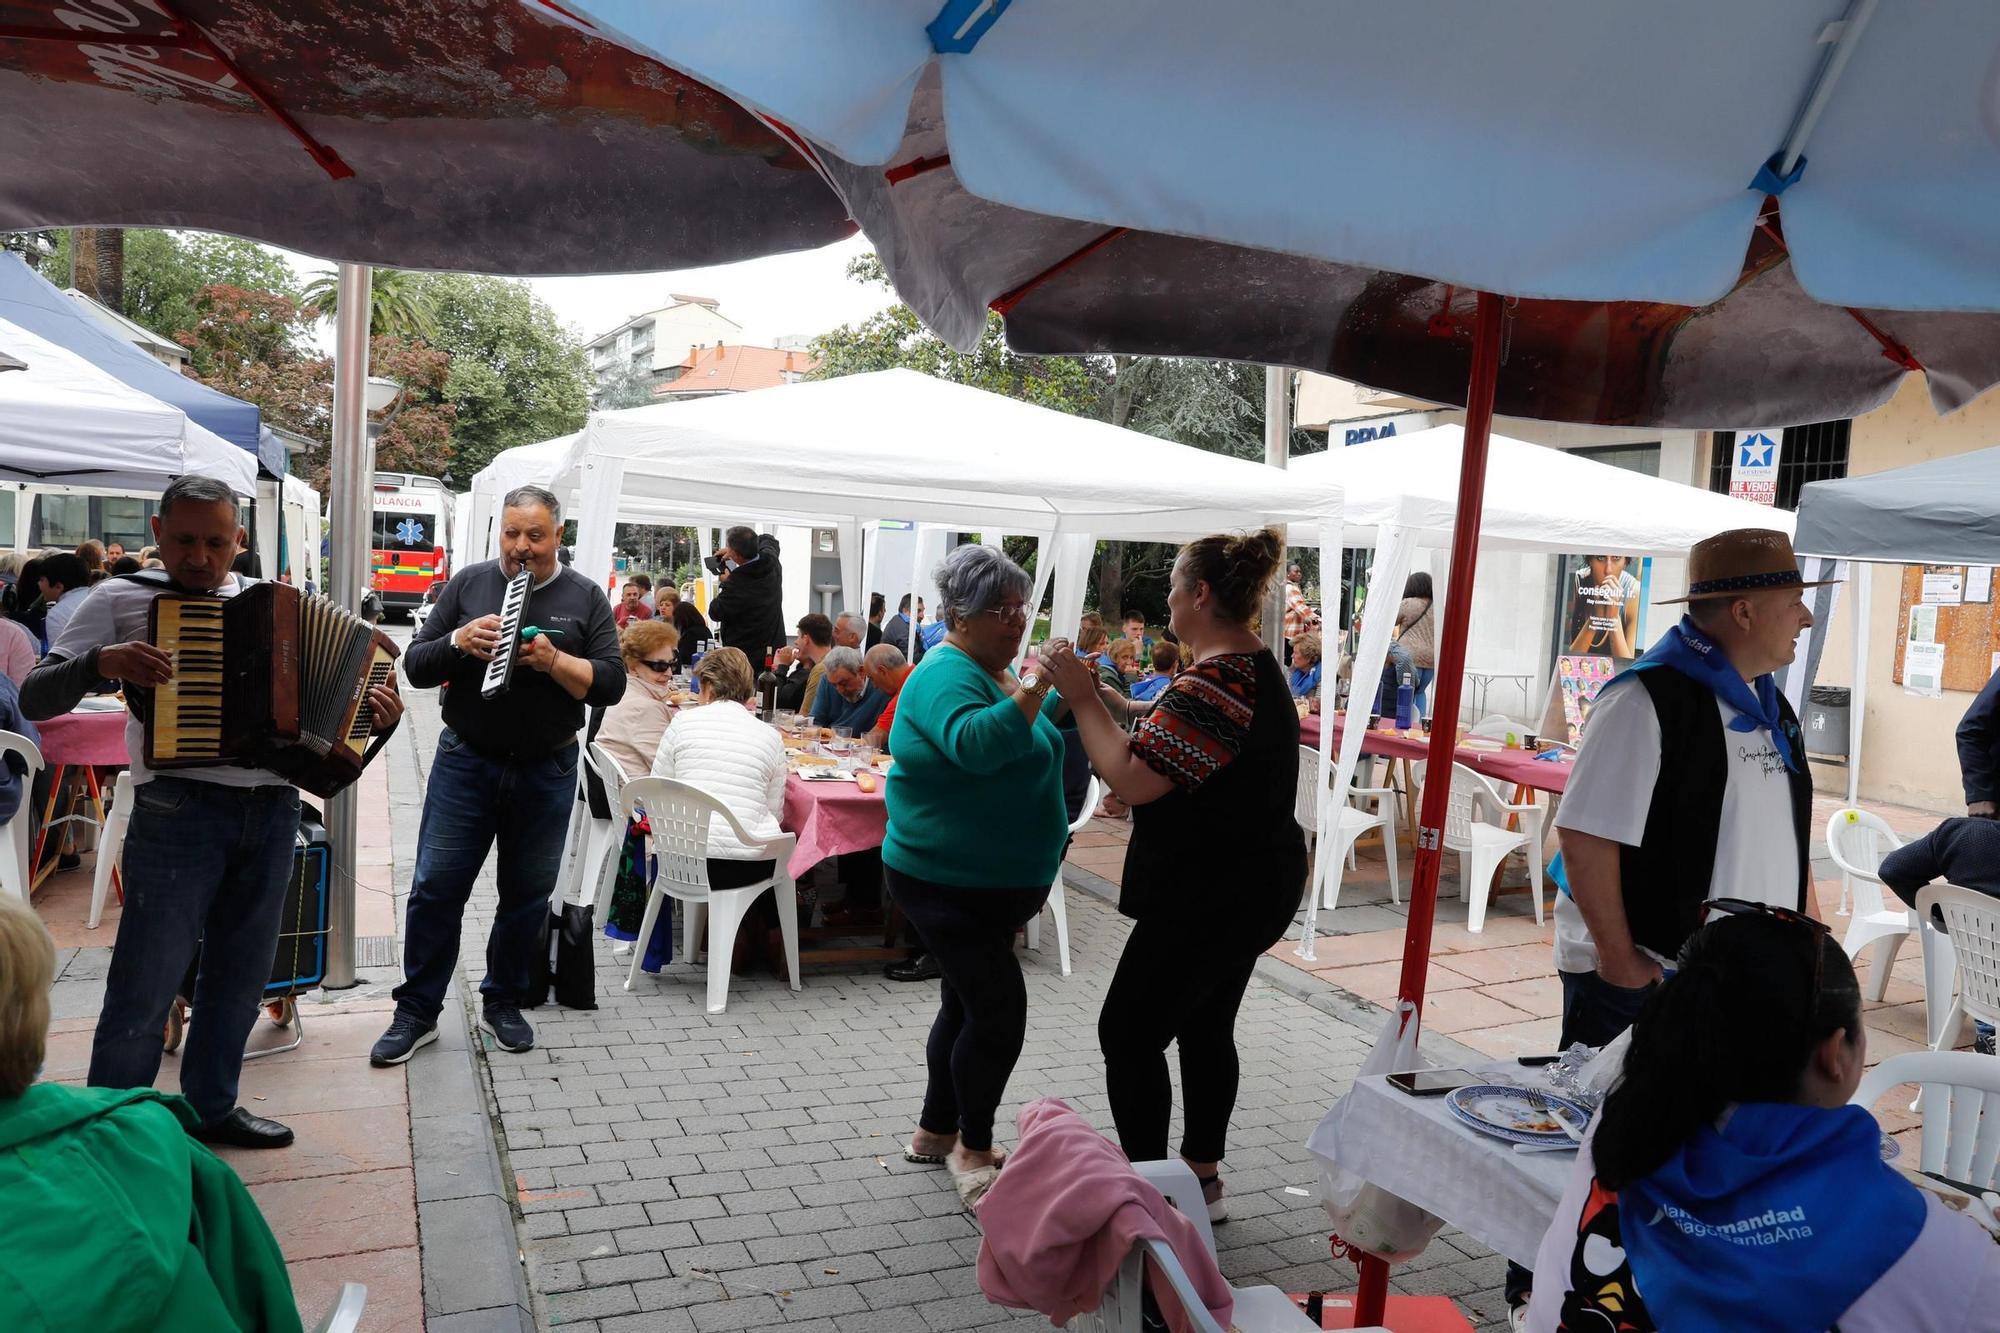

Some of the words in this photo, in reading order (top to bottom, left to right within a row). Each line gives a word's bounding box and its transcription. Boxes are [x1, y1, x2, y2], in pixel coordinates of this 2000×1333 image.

[1345, 422, 1397, 446] BBVA
[1732, 481, 1744, 492] ME
[1746, 481, 1775, 492] VENDE
[374, 497, 422, 507] ULANCIA
